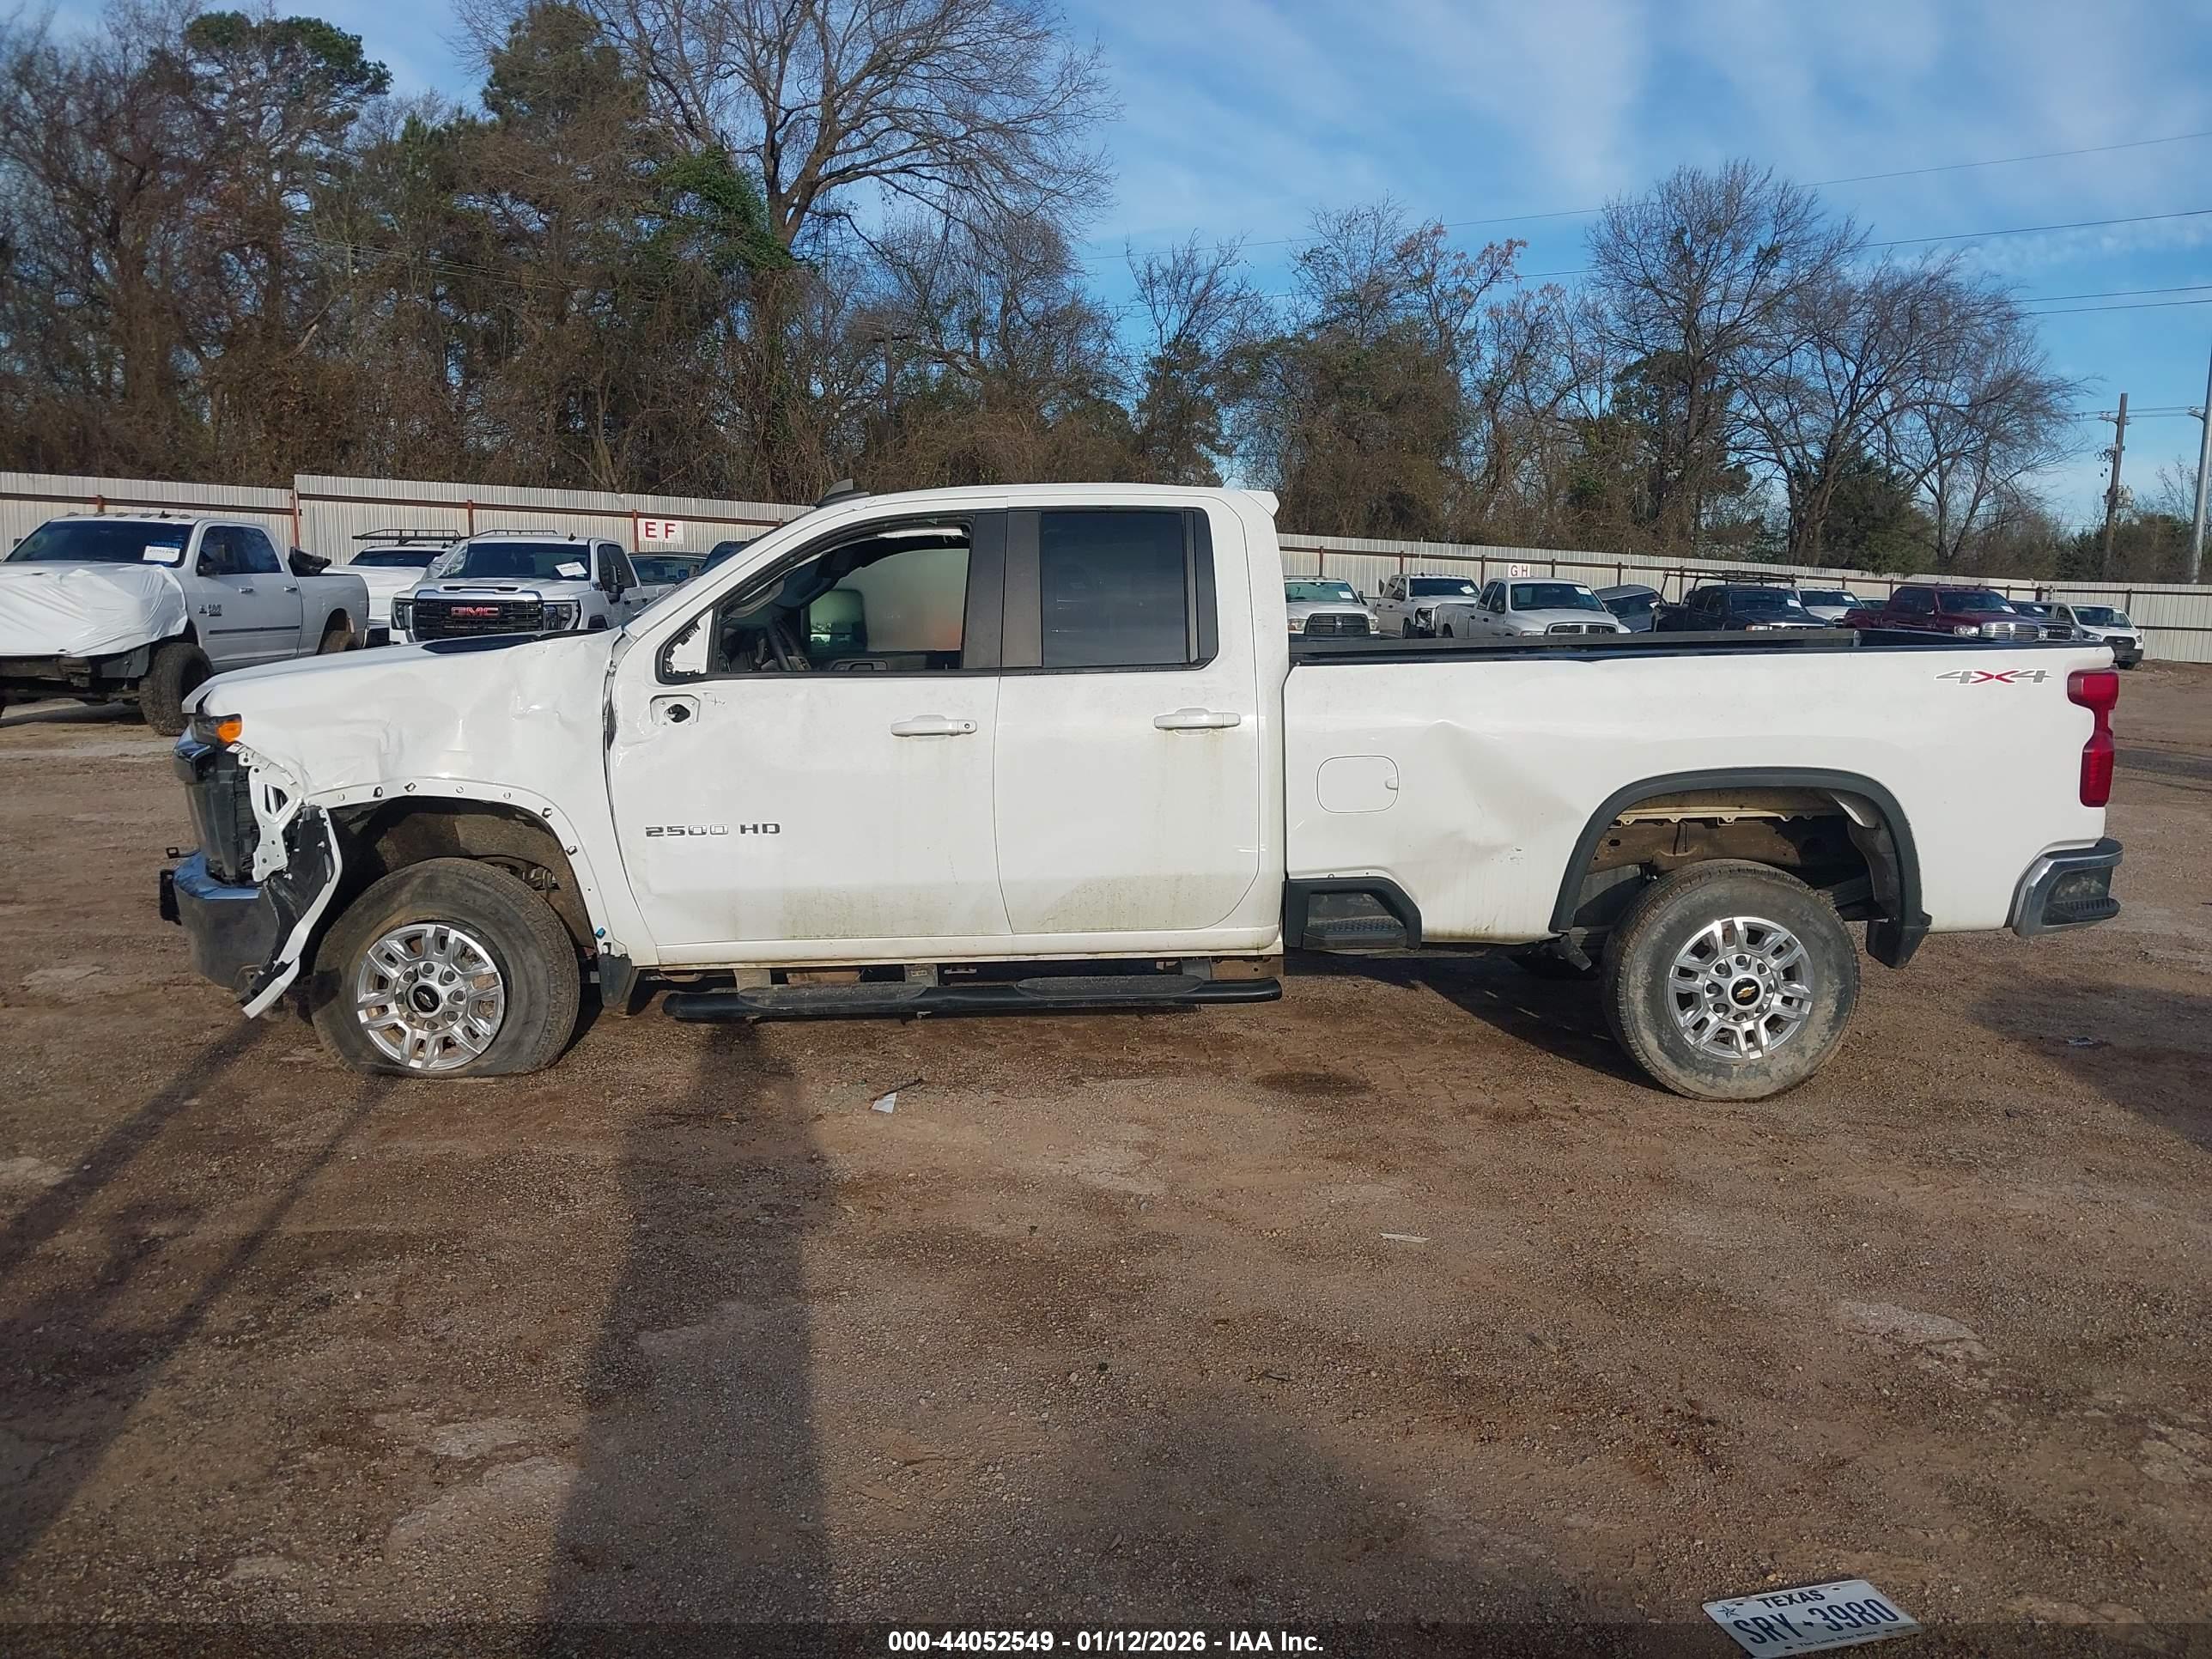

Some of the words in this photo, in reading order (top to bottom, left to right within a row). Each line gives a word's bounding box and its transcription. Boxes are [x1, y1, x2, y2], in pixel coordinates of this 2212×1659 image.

[451, 606, 500, 617] GMC
[645, 824, 728, 837] 2500
[739, 823, 781, 835] HD
[1756, 1589, 1826, 1609] TEXAS
